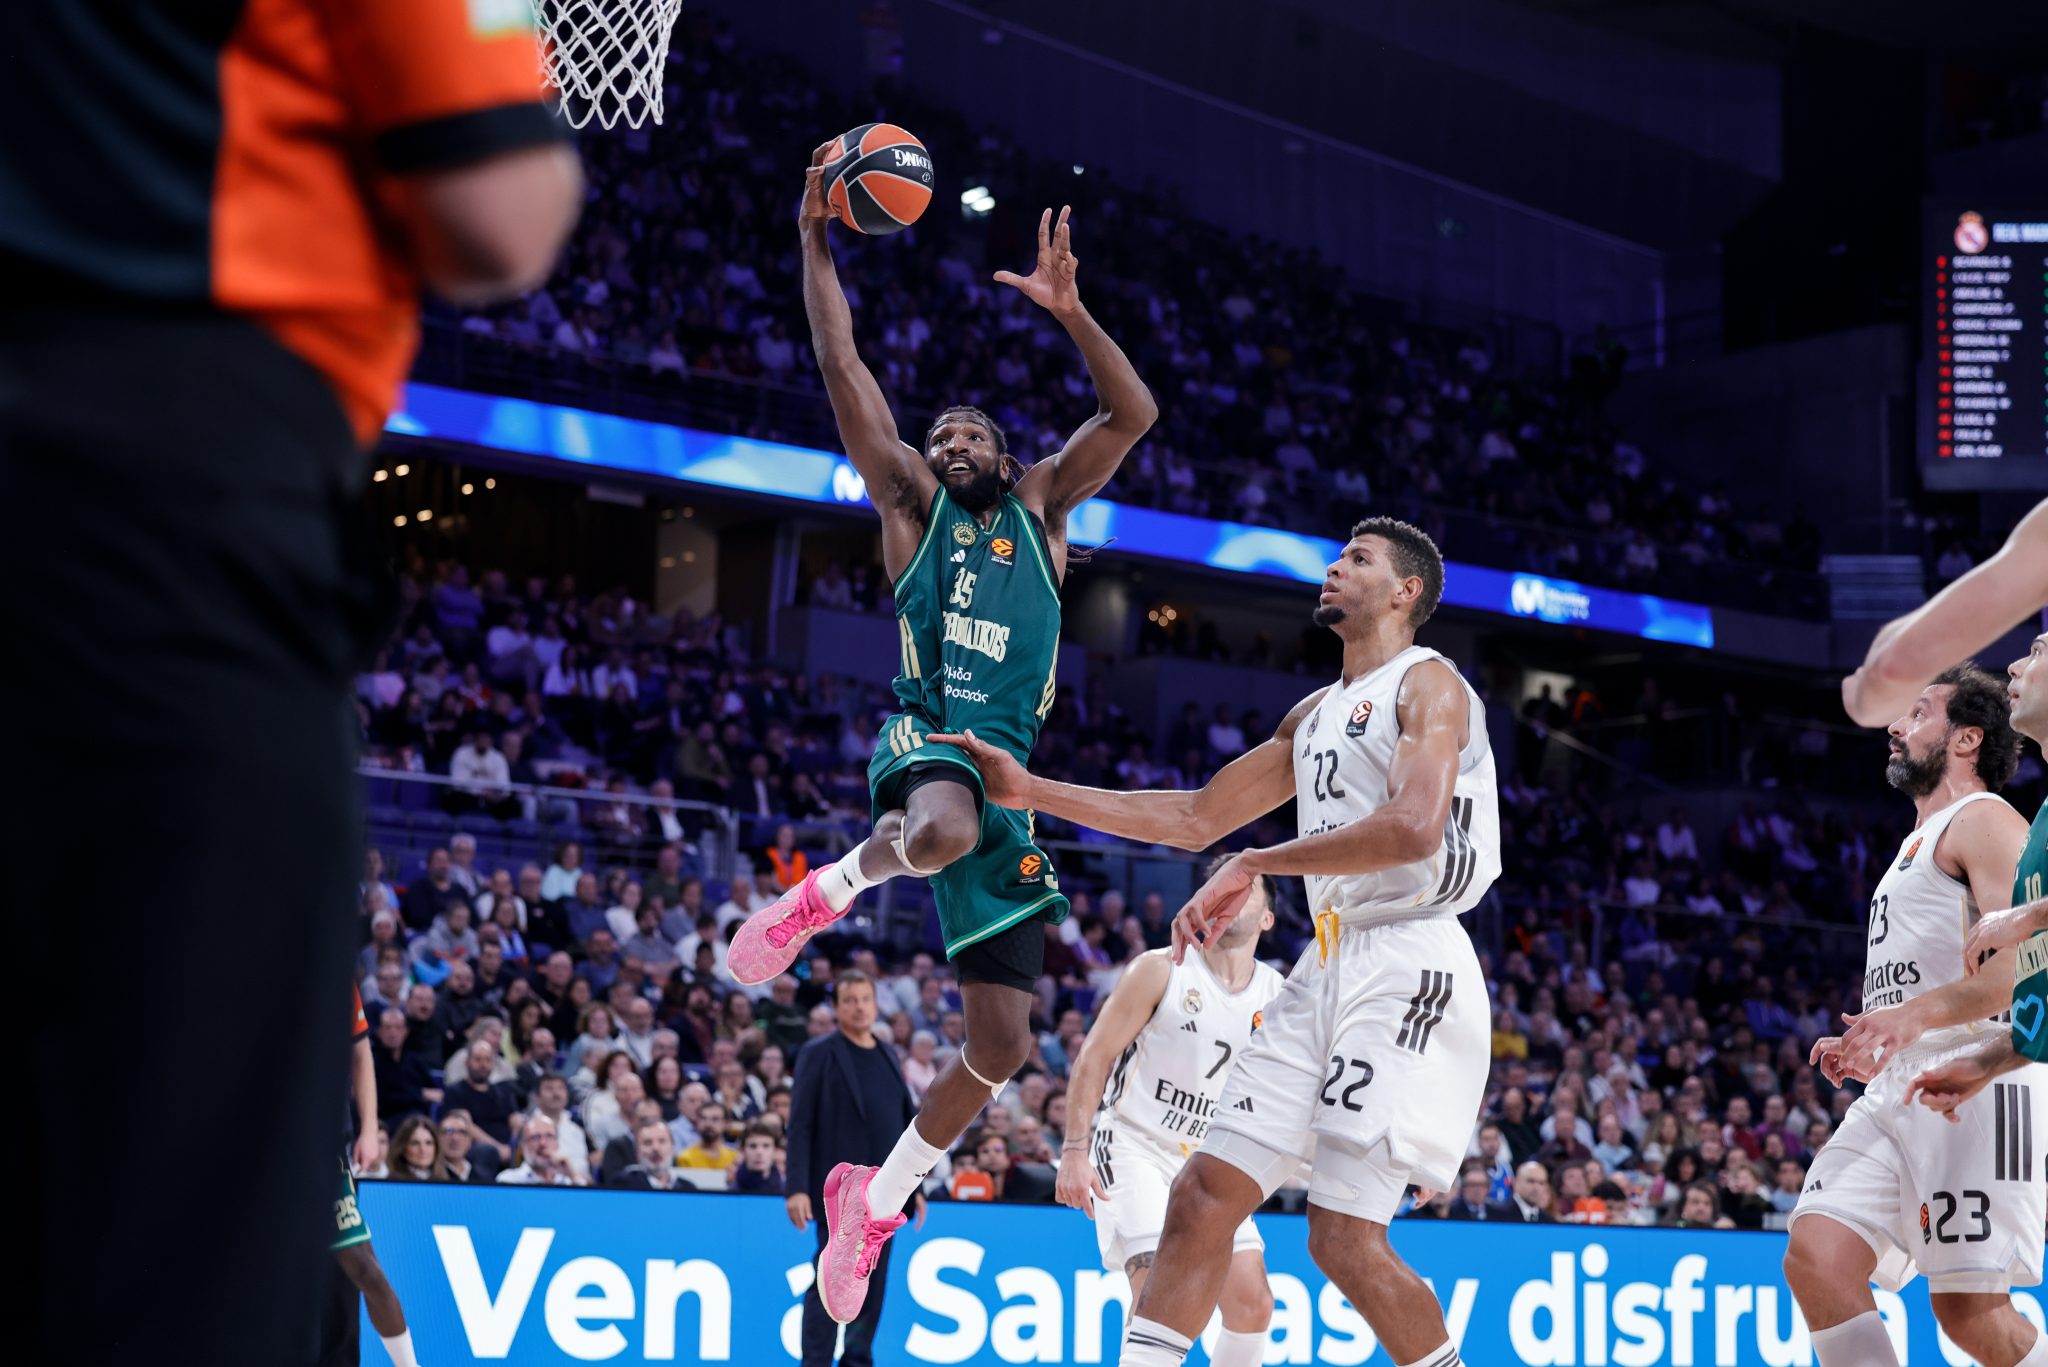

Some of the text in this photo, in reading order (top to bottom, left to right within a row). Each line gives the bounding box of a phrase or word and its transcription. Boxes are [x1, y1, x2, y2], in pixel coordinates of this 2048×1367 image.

[949, 567, 978, 609] 35
[1314, 749, 1345, 802] 22
[1870, 894, 1889, 948] 23
[1205, 1039, 1232, 1080] 7
[1320, 1055, 1374, 1112] 22
[1161, 1109, 1188, 1132] FLY
[1933, 1190, 1992, 1244] 23
[432, 1225, 732, 1361] Ven
